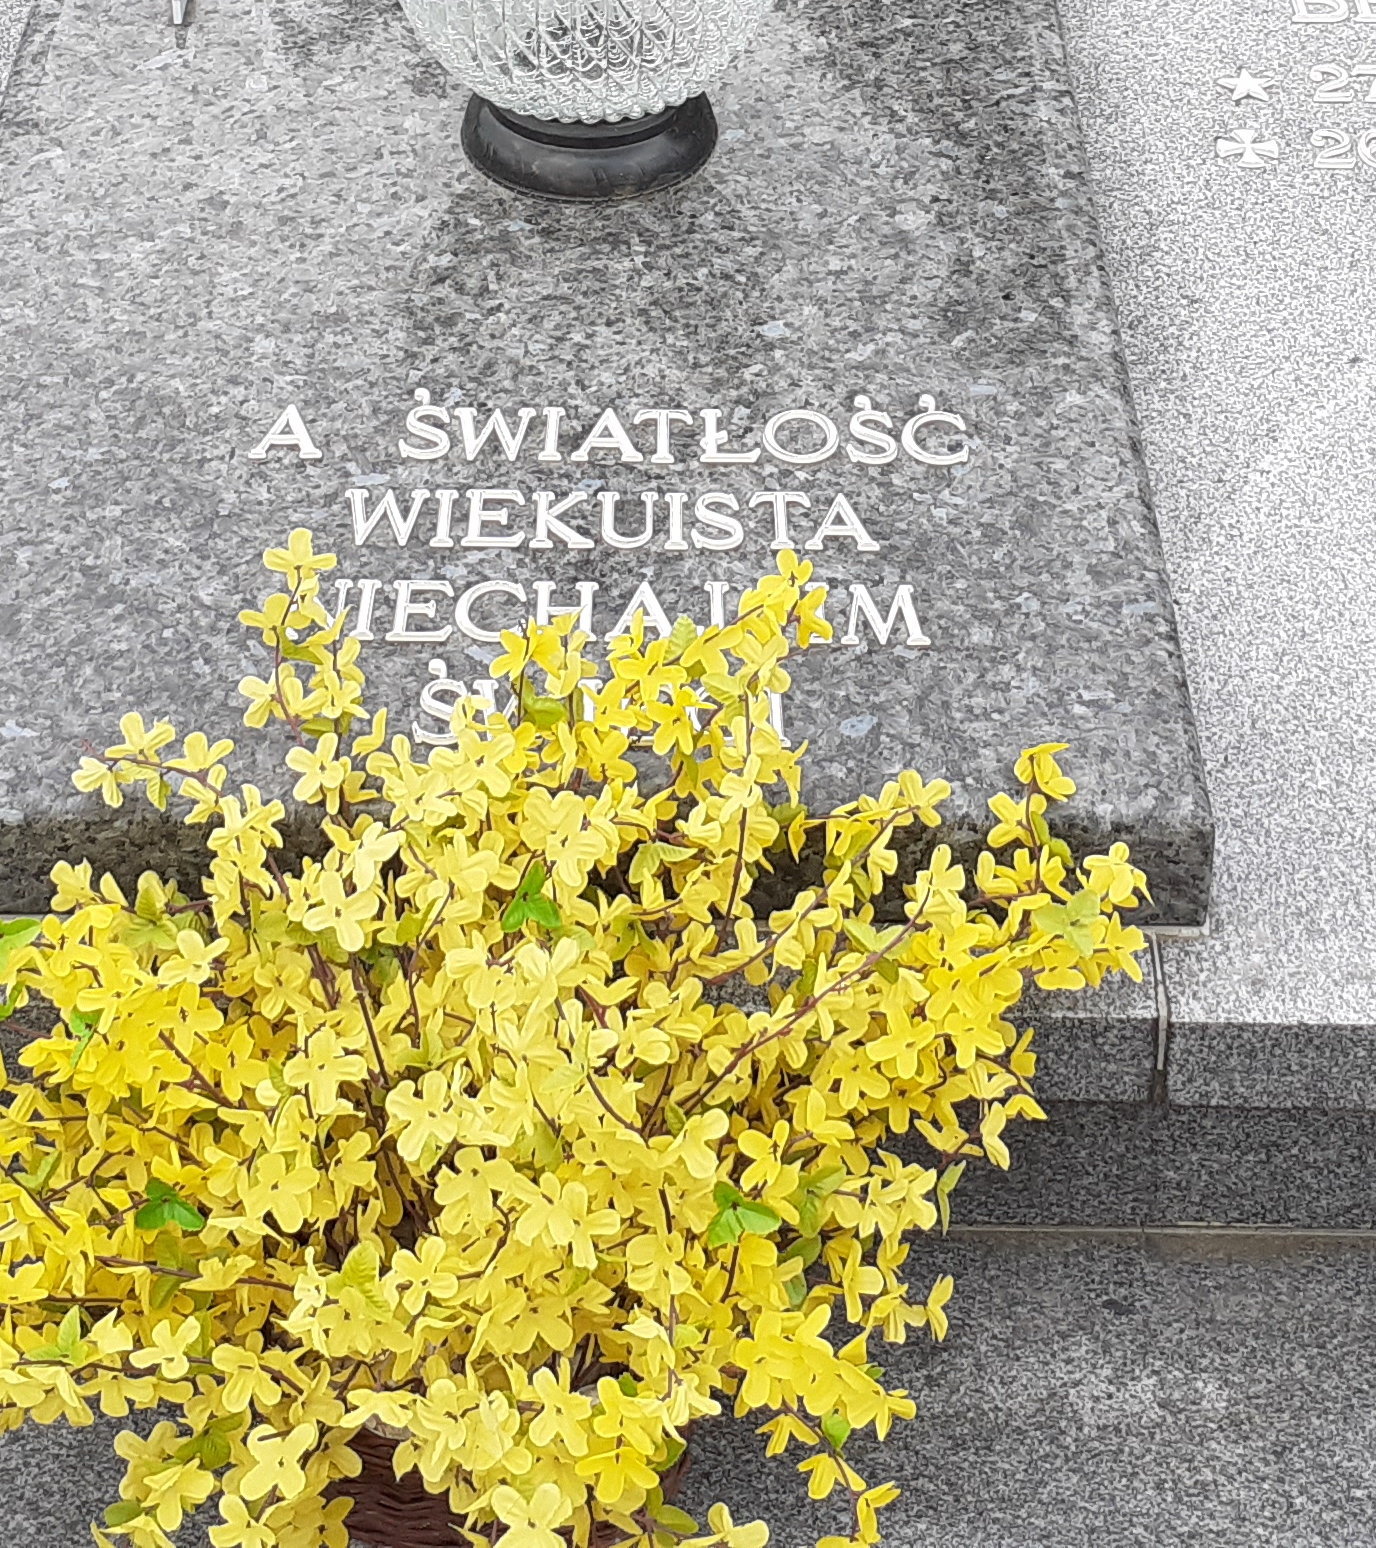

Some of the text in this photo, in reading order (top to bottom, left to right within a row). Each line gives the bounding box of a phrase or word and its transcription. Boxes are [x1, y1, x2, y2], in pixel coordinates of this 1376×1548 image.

[248, 387, 971, 466] A ŚWIATŁOŚĆ
[345, 487, 880, 552] WIEKUISTA
